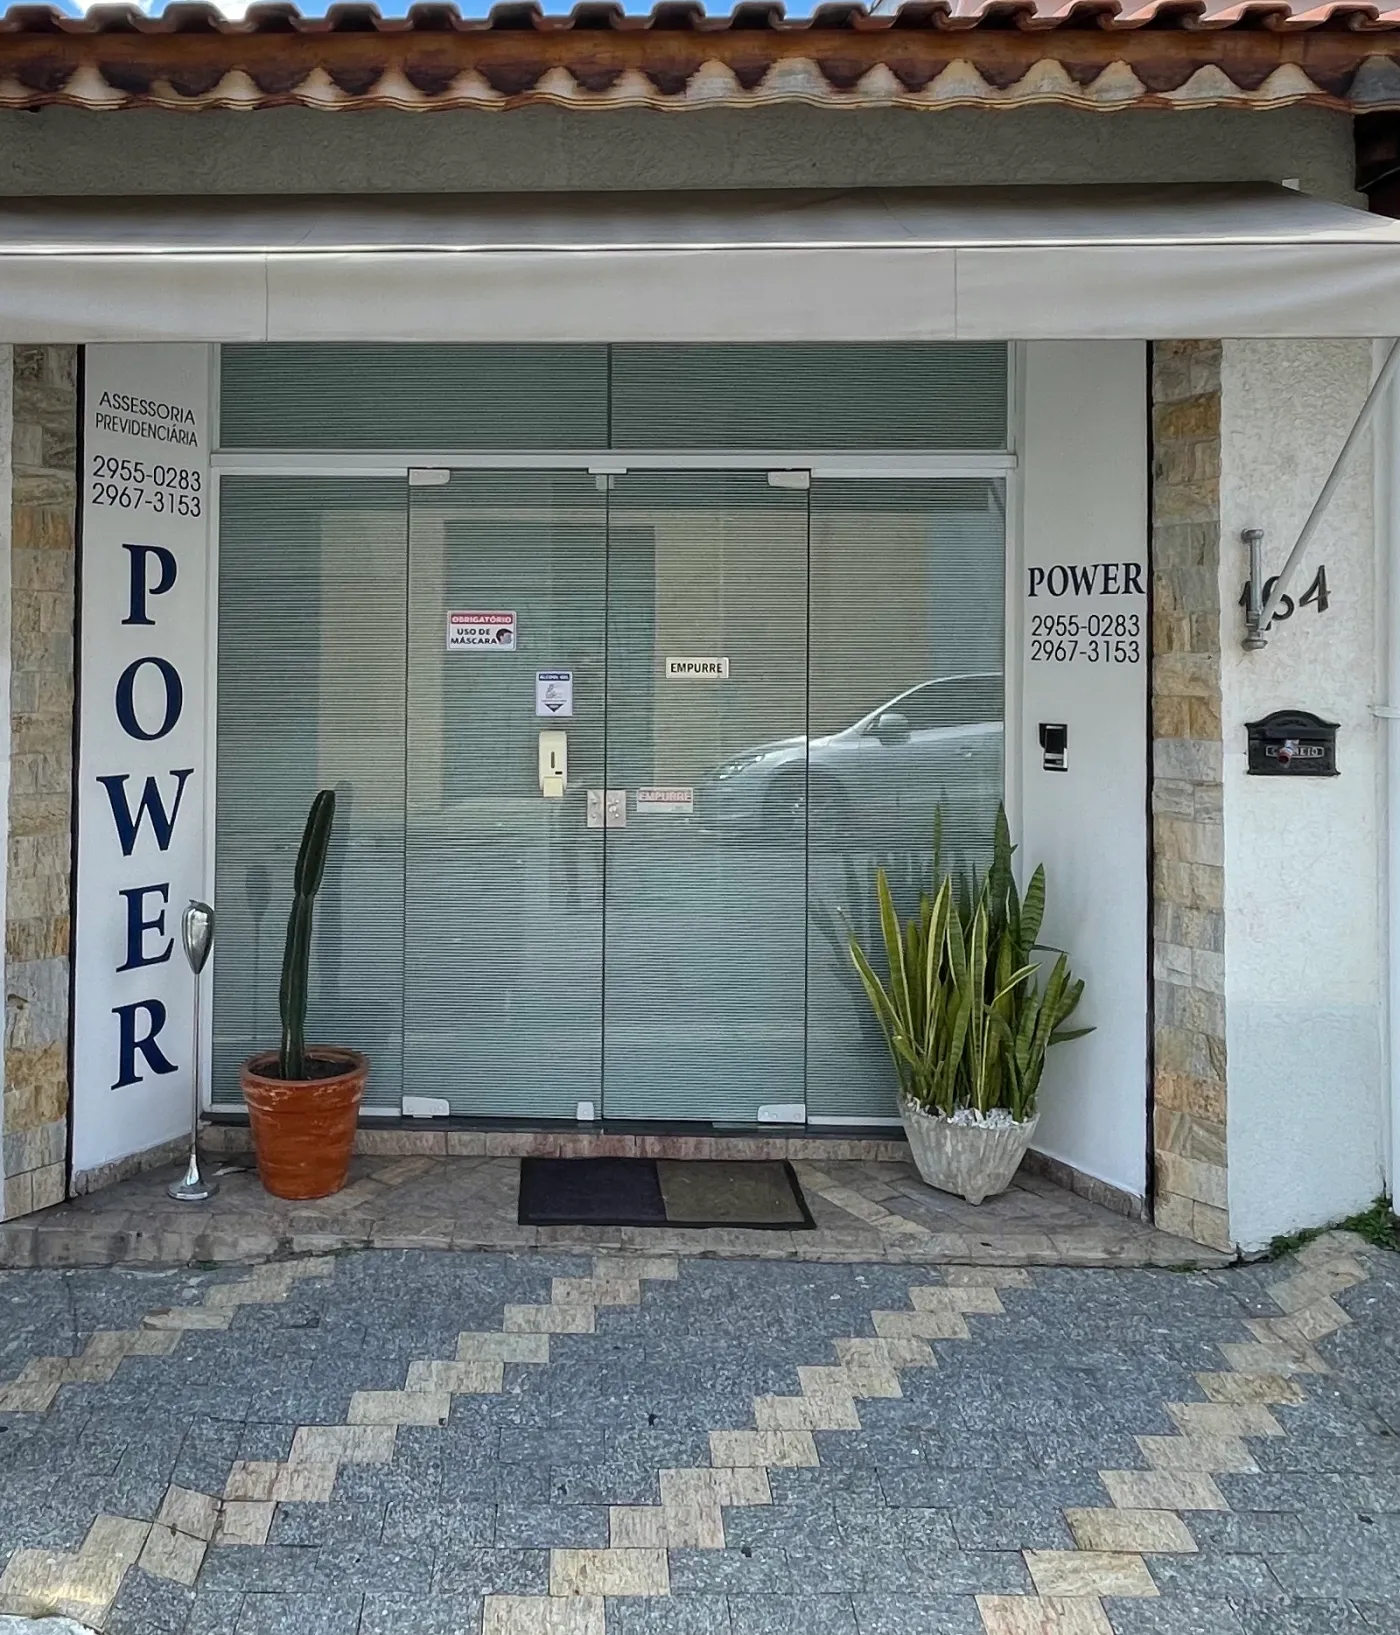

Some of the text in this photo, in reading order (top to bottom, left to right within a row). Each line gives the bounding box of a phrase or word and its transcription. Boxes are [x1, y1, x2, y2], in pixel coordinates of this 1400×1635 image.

[99, 391, 195, 425] ASSESSORIA
[95, 412, 198, 447] PREVIDENCIÁRIA
[92, 455, 201, 492] 2955-0283
[92, 482, 201, 517] 2967-3153
[1027, 562, 1146, 597] POWER
[1031, 614, 1140, 637] 2955-0283
[670, 663, 722, 673] EMPURRE
[1031, 640, 1140, 663] 2967-3153
[96, 543, 195, 1090] POWER
